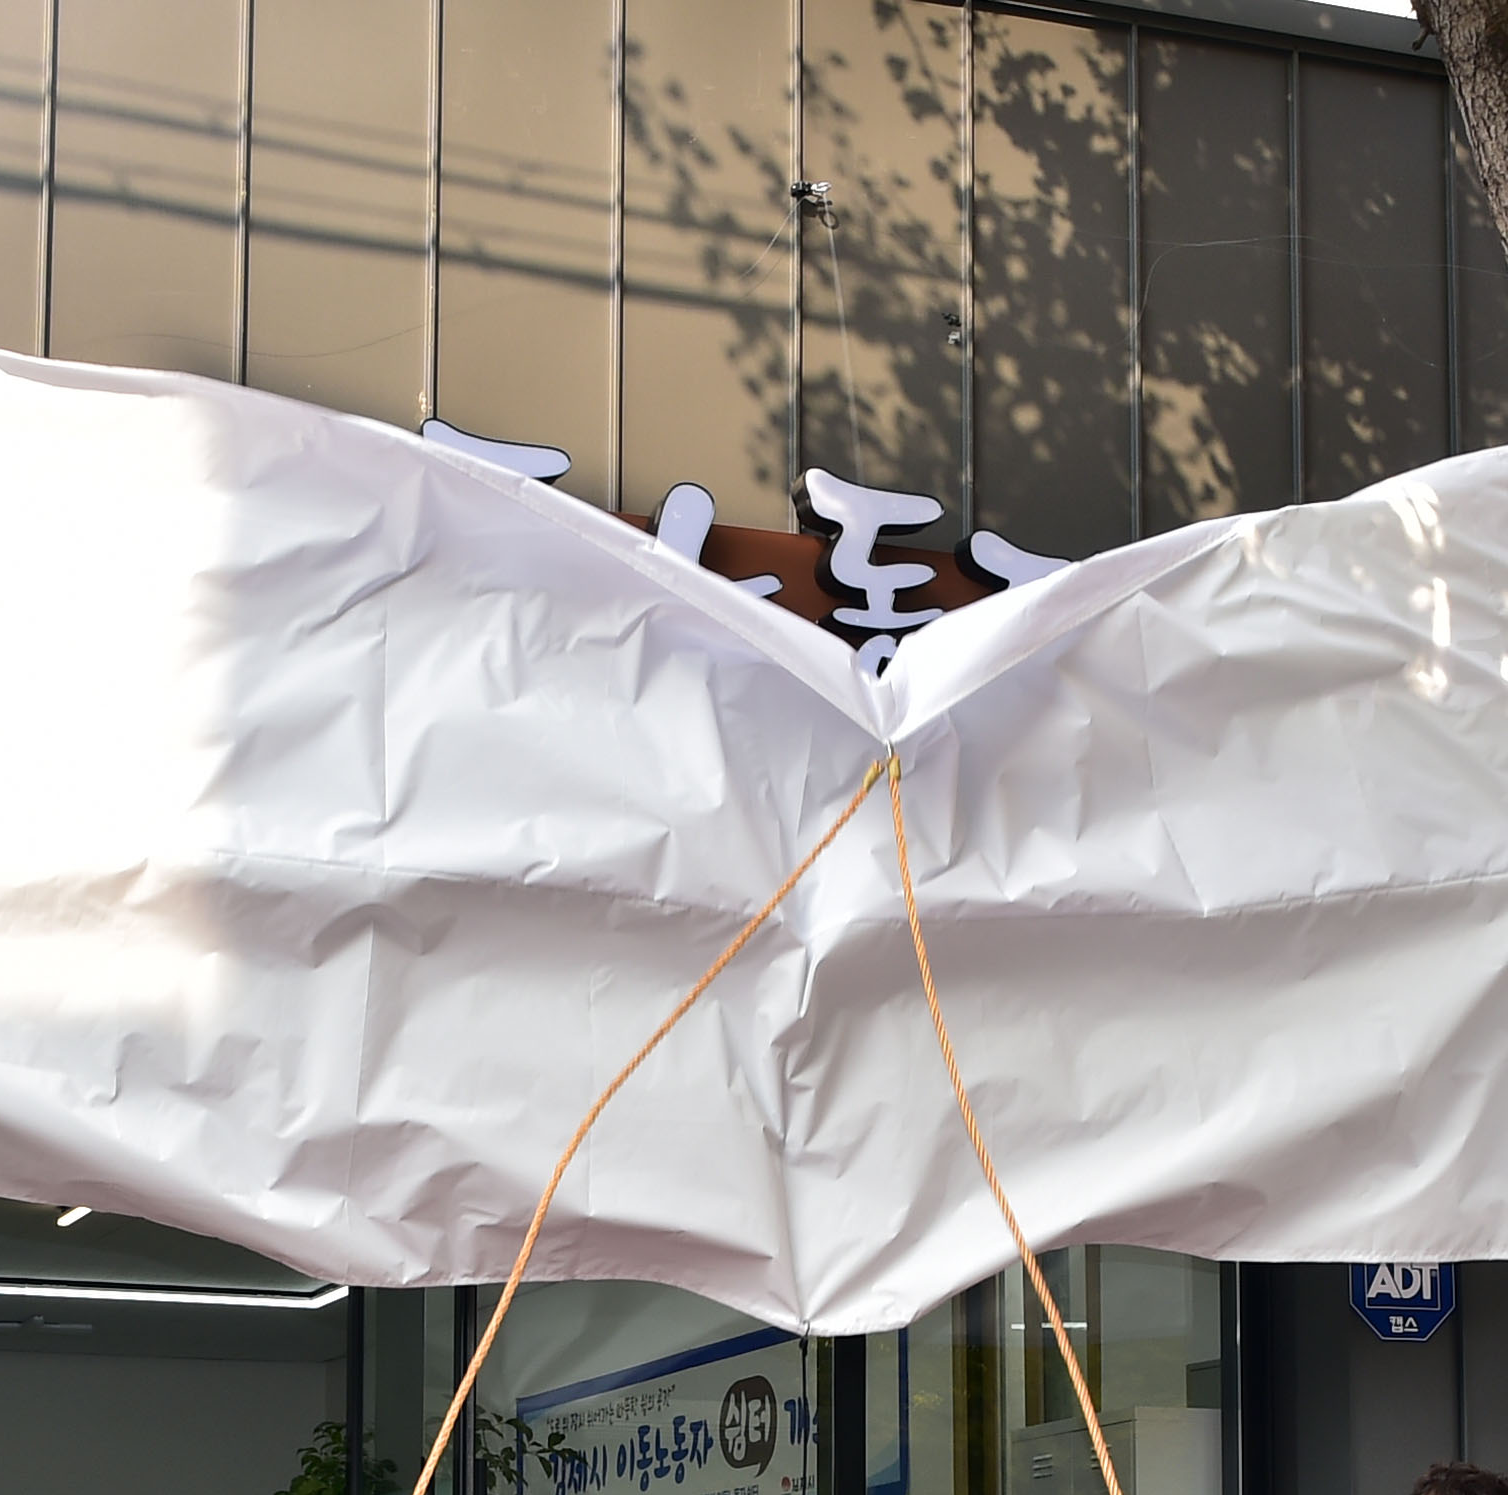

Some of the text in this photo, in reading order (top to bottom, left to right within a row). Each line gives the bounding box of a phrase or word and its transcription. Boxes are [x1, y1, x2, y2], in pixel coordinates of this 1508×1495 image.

[1367, 1263, 1439, 1300] ADT
[1389, 1315, 1419, 1333] 캡스
[616, 1415, 714, 1492] 이동노동자
[724, 1389, 771, 1461] 쉼터
